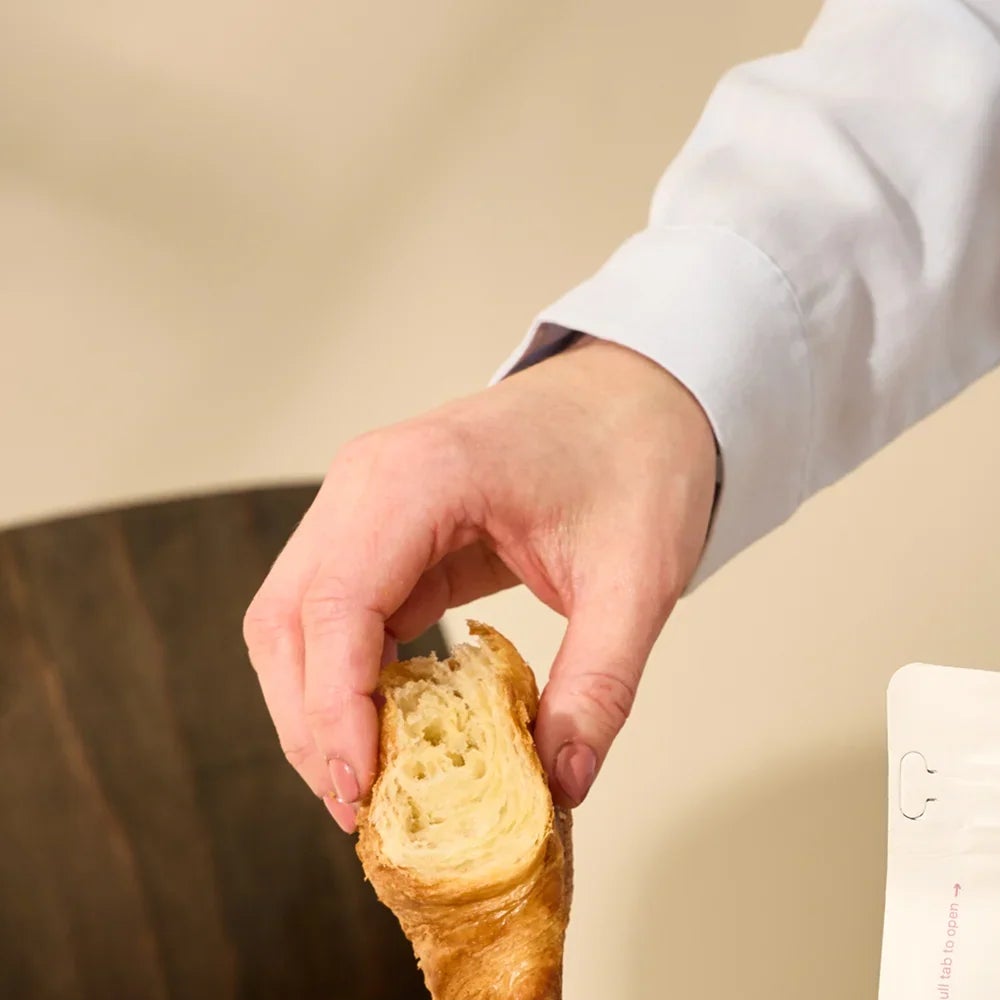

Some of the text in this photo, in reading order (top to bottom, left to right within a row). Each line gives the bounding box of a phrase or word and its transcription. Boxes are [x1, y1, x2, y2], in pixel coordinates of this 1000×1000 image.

[947, 902, 959, 937] open
[944, 940, 954, 953] to
[940, 956, 953, 980] tab
